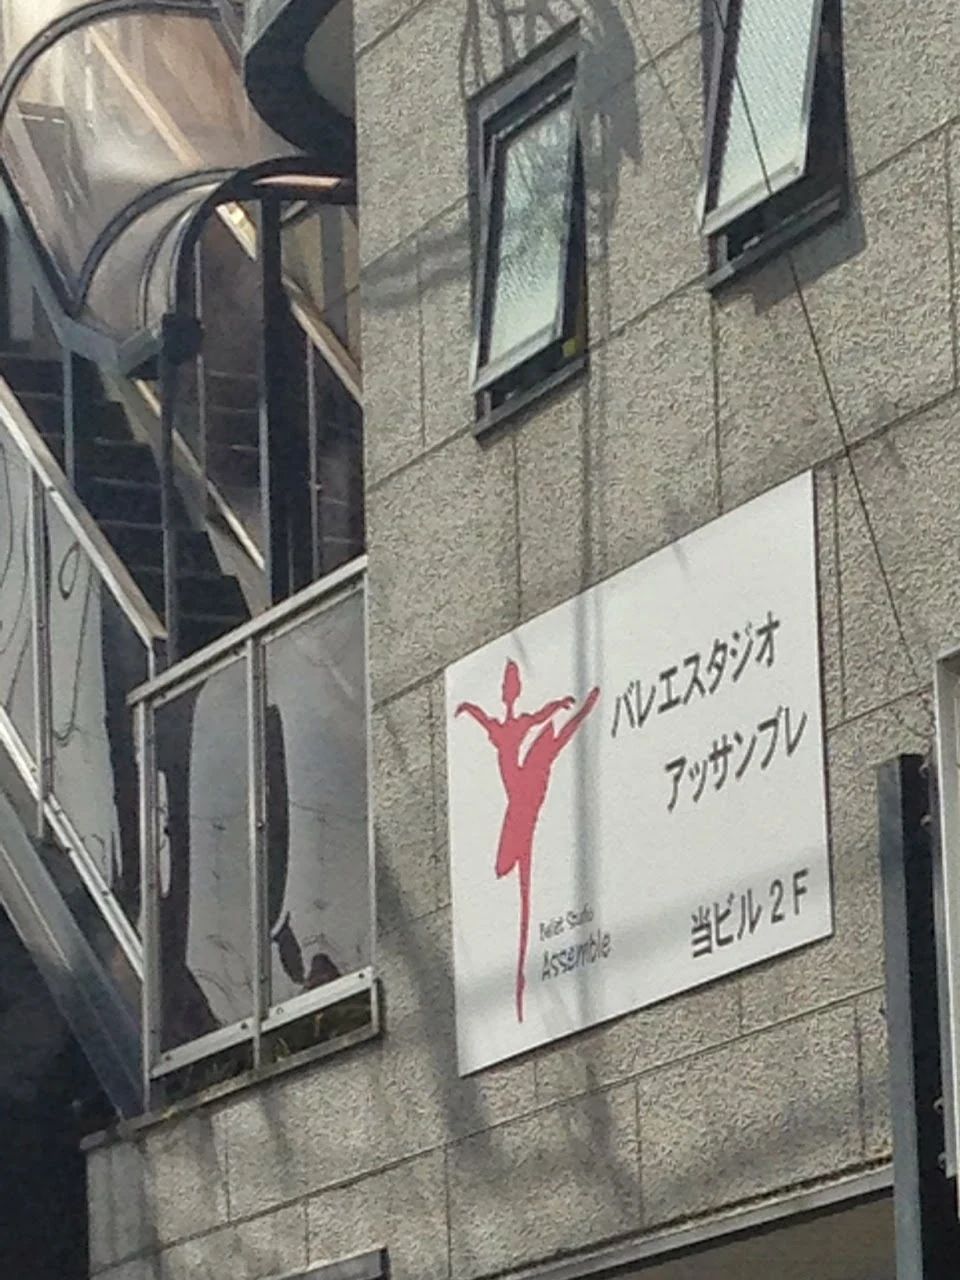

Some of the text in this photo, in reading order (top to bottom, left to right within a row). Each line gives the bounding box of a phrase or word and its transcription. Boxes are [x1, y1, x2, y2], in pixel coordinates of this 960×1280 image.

[609, 610, 781, 738] バレエスタジオ
[664, 705, 808, 813] アッサンブレ
[540, 928, 612, 981] Assemble
